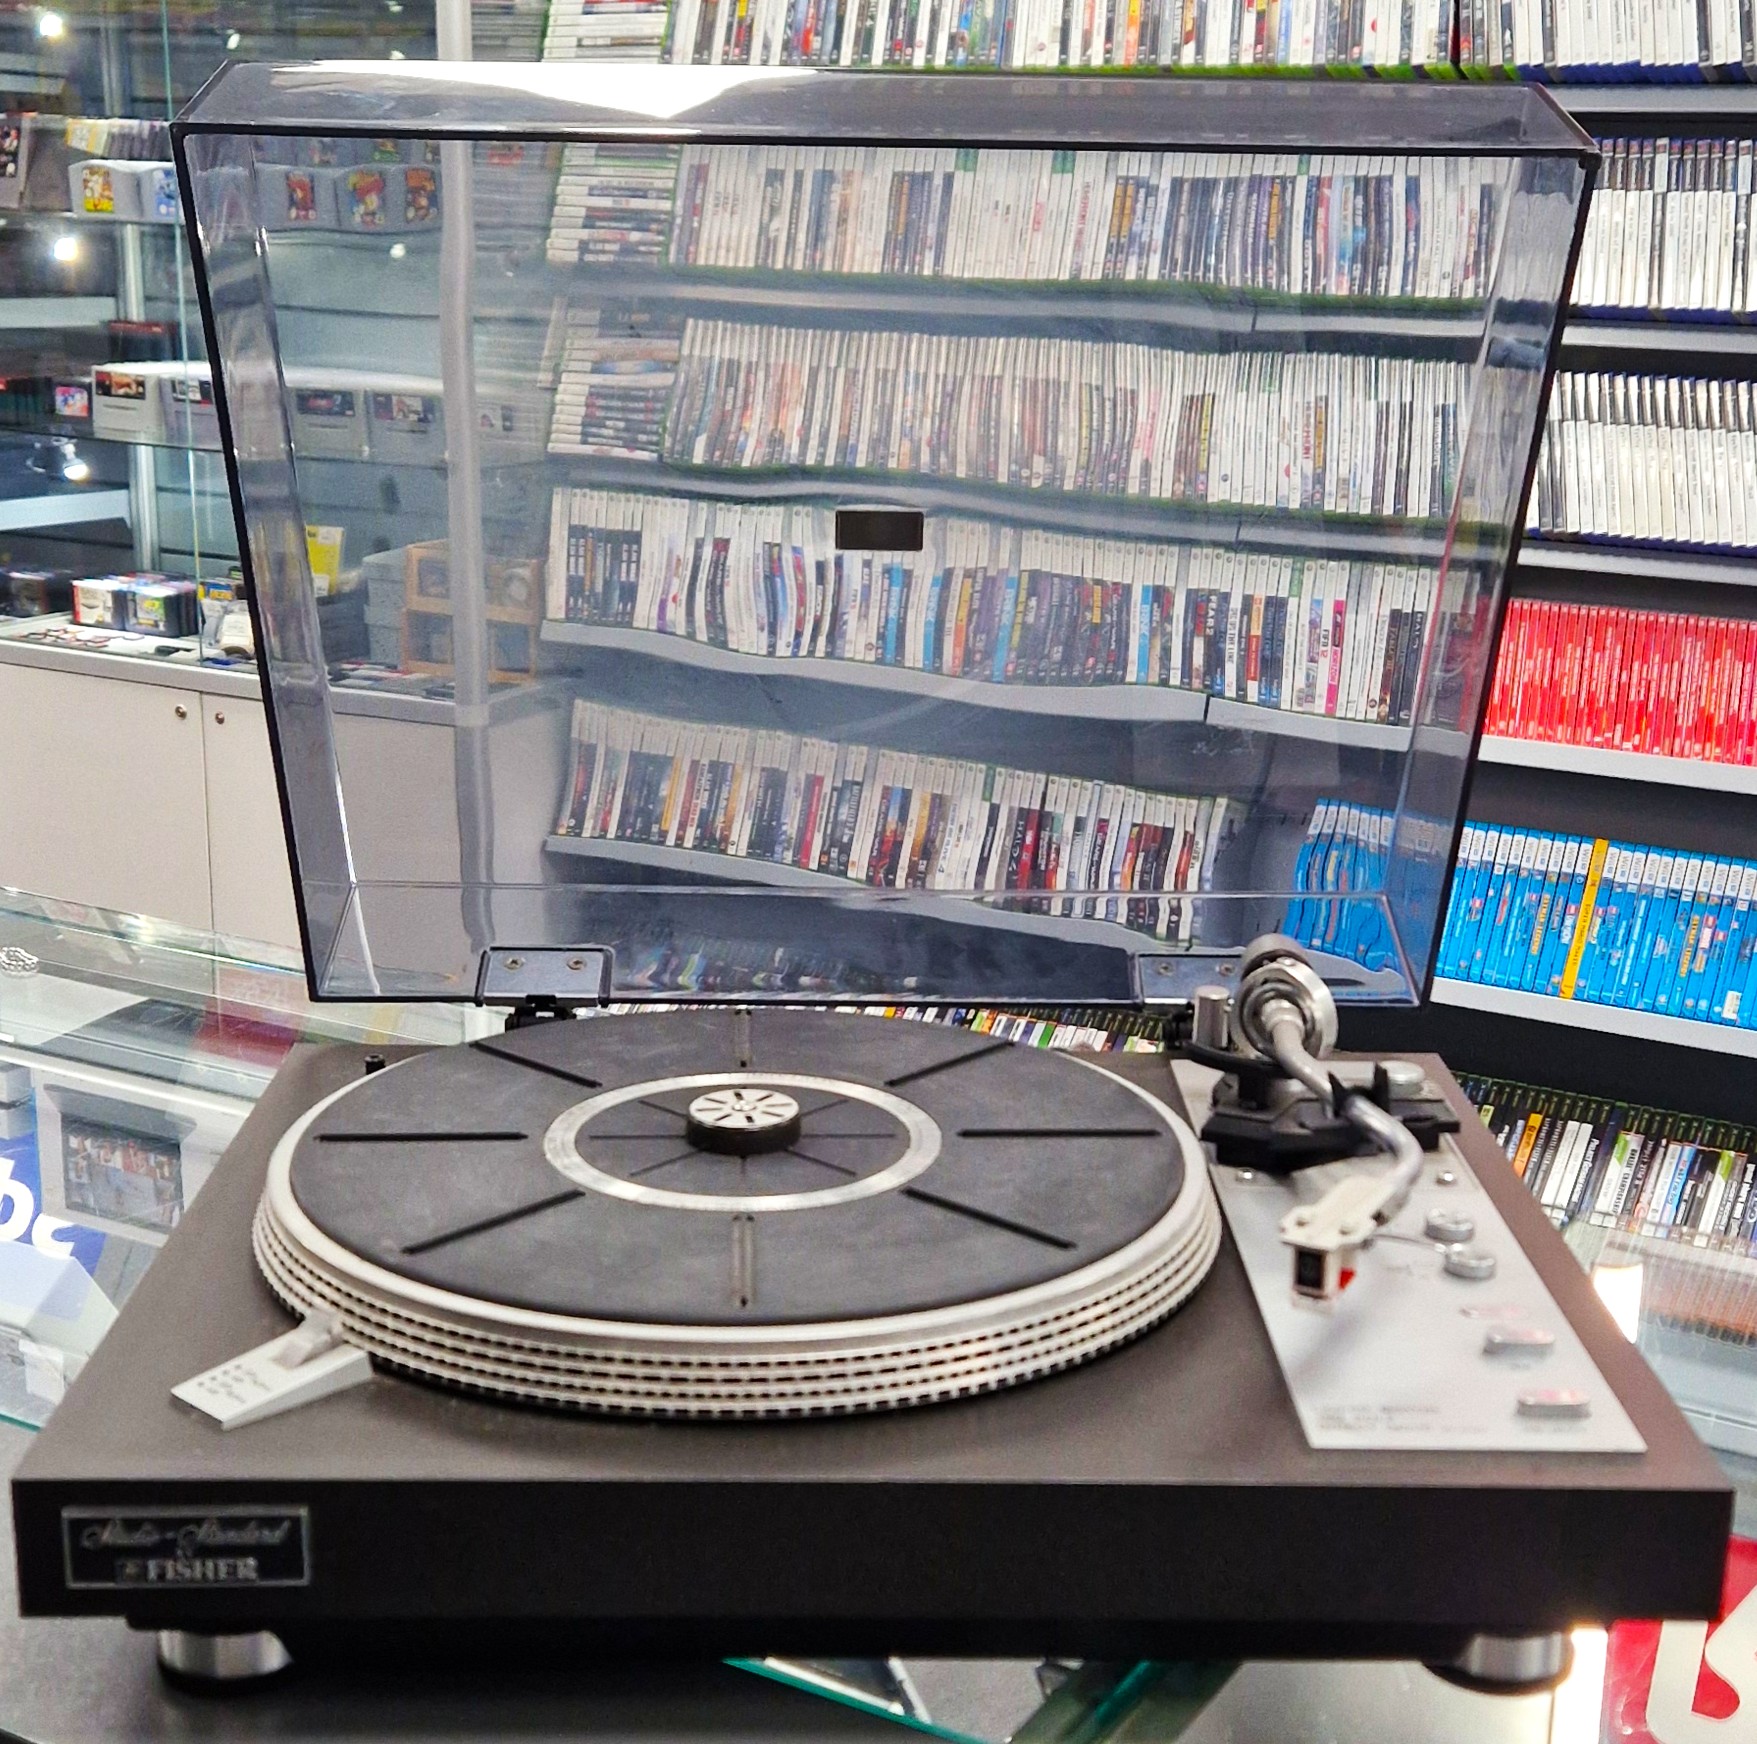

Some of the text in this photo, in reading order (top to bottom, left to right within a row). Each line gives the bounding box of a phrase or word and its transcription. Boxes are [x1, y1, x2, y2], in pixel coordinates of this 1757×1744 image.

[1320, 628, 1329, 658] FIFA 12
[1329, 648, 1339, 682] HORIZON
[1010, 820, 1024, 857] HALO
[146, 1557, 259, 1583] FISHER
